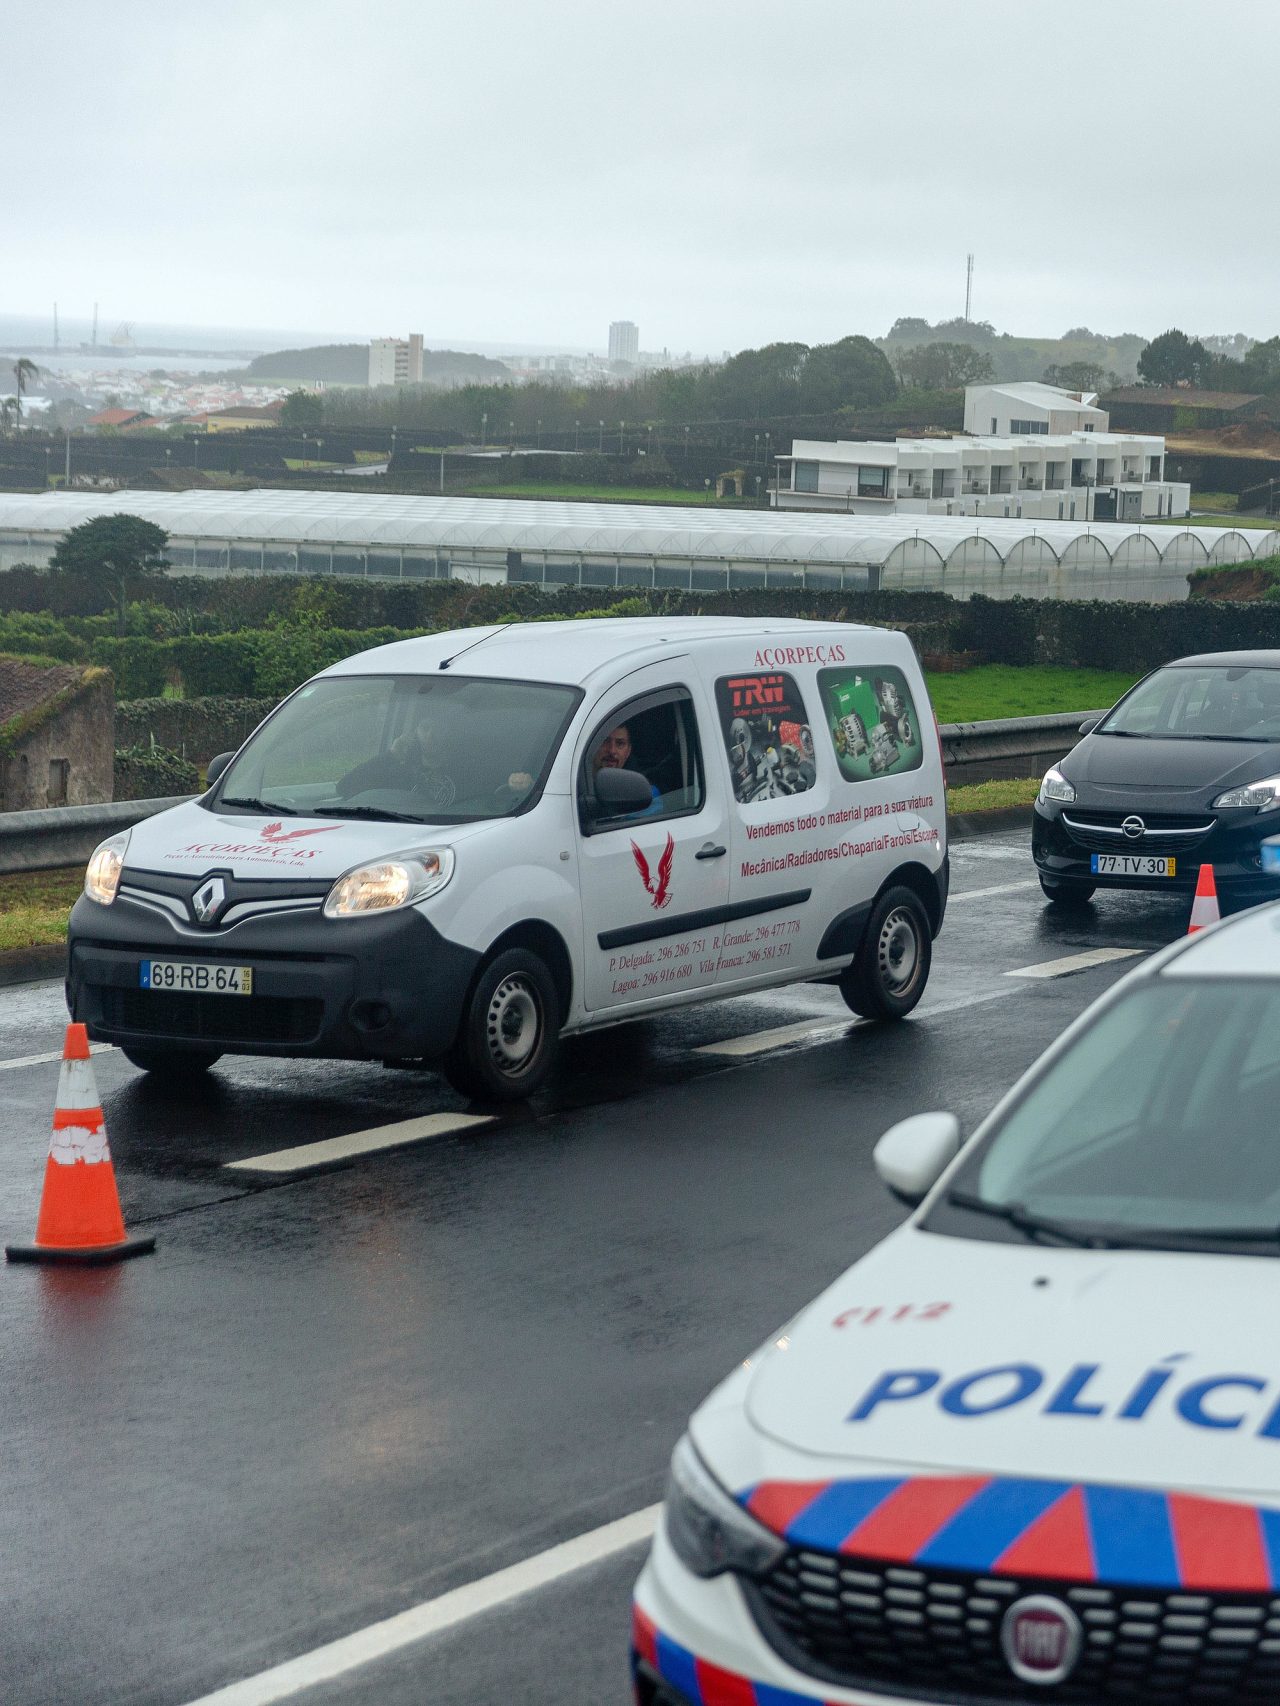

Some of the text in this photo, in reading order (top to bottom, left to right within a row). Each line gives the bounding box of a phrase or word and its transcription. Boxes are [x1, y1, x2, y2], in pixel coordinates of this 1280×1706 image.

[754, 644, 846, 669] AÇORPEÇAS
[727, 675, 784, 707] TRW
[746, 795, 933, 840] Vendemos todo o material para a sua viatura
[176, 843, 324, 859] AÇORPEÇAS
[608, 919, 801, 972] P. Delgada: 296 286 751 R. Grande: 296 477 778
[611, 978, 641, 995] Lagoa:
[642, 971, 658, 987] 296
[659, 967, 675, 982] 916
[676, 963, 693, 979] 680
[699, 959, 714, 974] Vila
[715, 955, 745, 971] Franca:
[745, 950, 760, 964] 296
